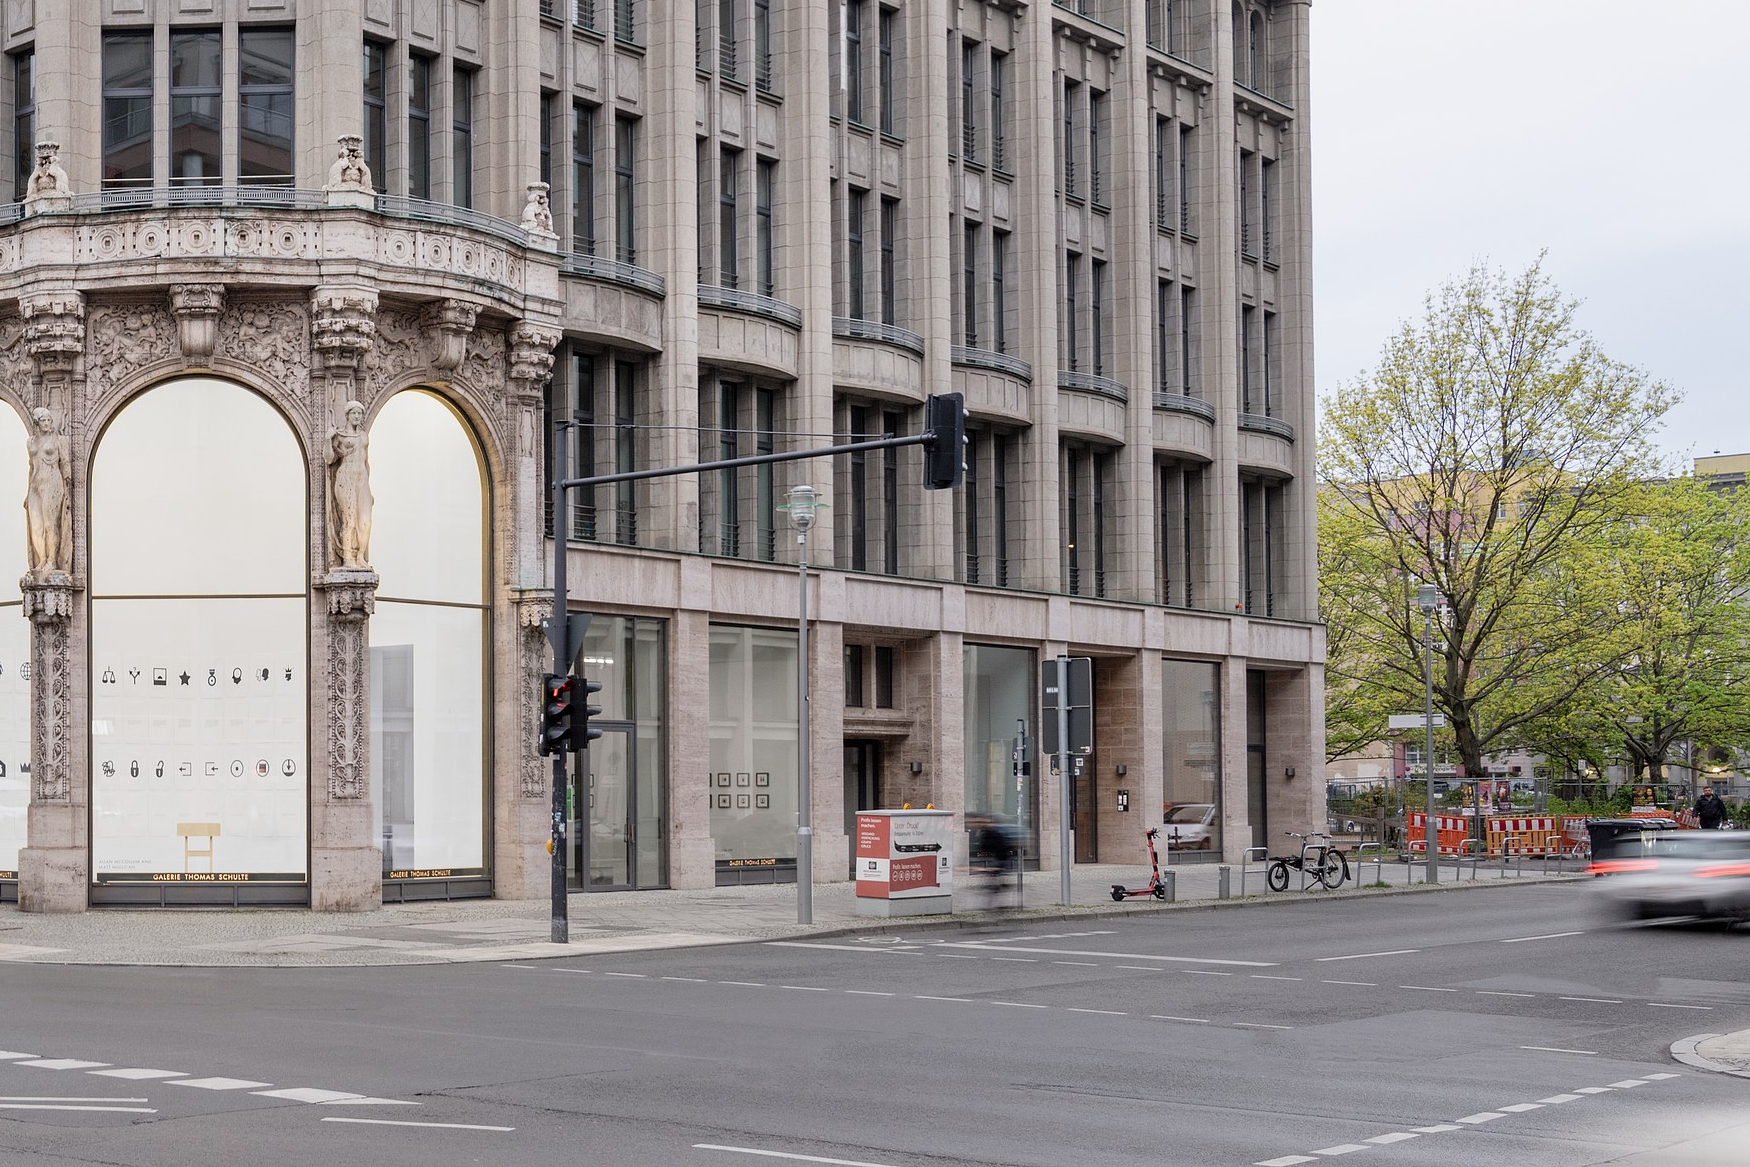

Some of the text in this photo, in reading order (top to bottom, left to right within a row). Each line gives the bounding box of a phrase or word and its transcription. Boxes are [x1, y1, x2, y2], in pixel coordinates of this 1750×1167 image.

[152, 873, 249, 881] GALERIE THOMAS SCHULTE
